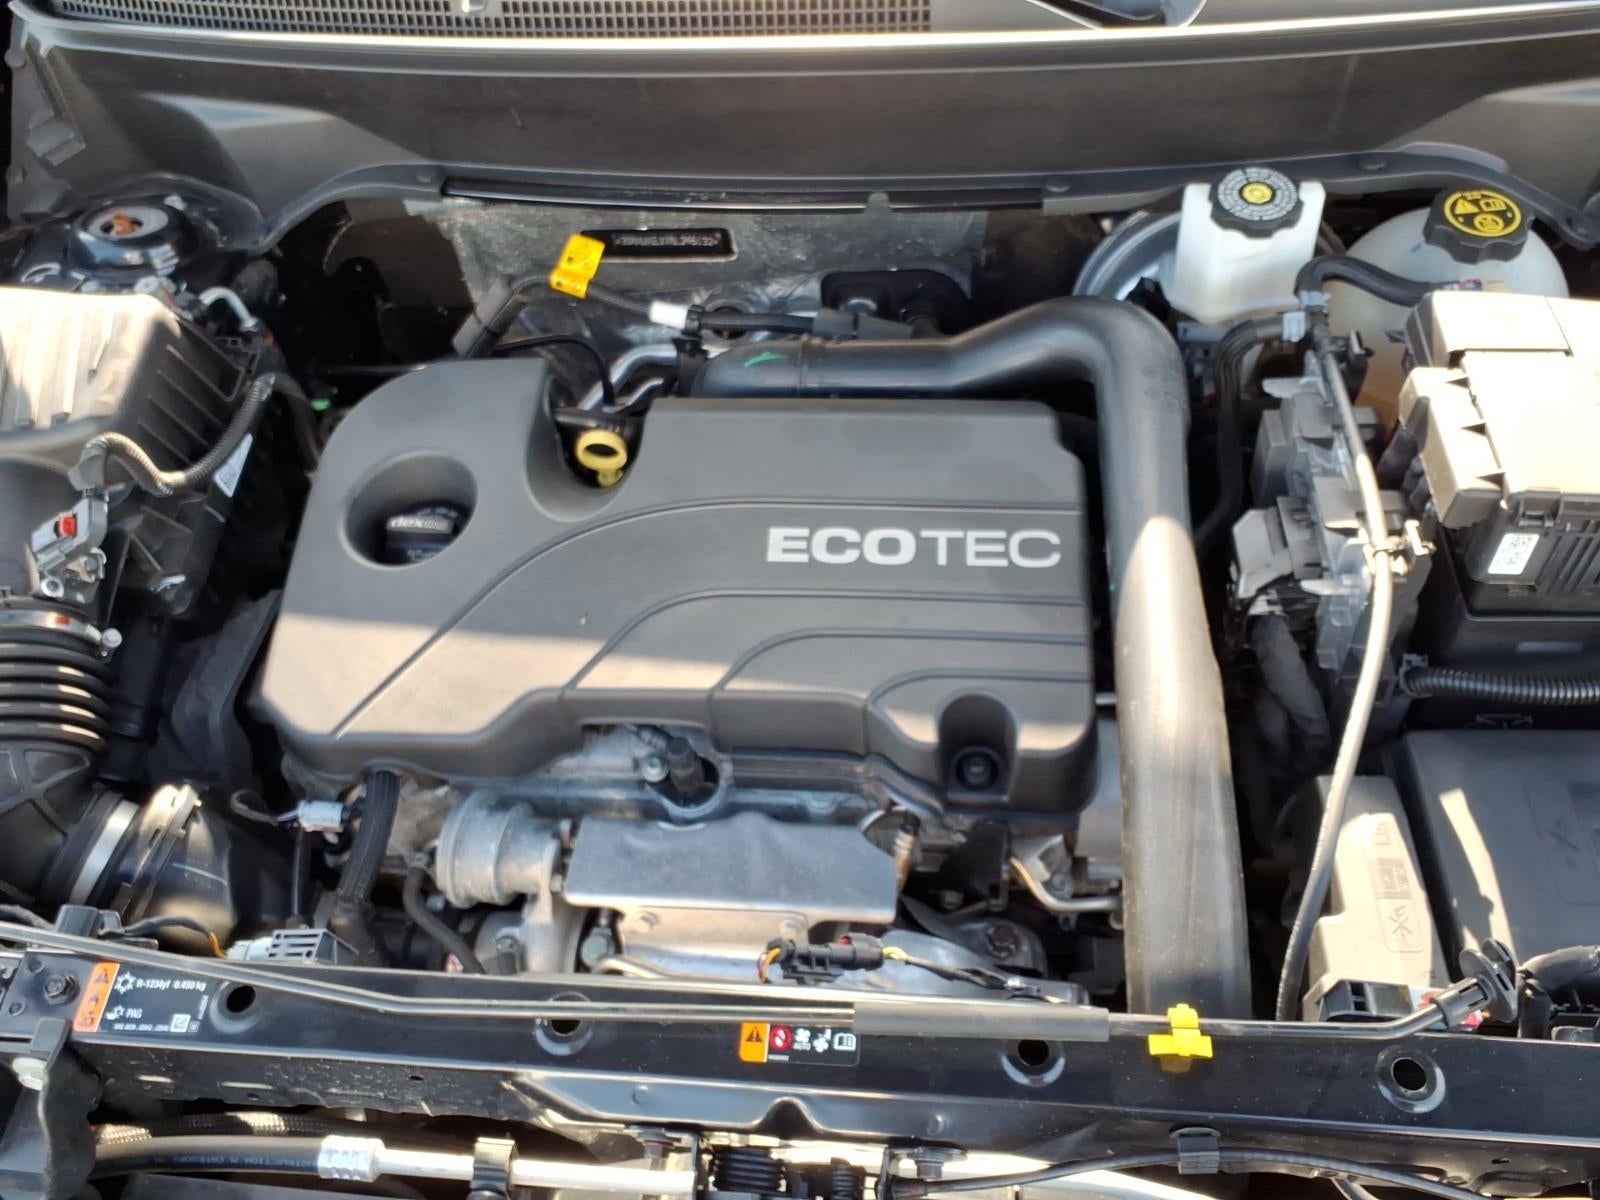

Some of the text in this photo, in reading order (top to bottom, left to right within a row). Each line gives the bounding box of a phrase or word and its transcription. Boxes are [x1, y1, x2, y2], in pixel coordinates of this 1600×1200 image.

[766, 526, 1062, 568] ECOTEC
[195, 981, 207, 992] kg
[126, 1008, 143, 1018] PAG
